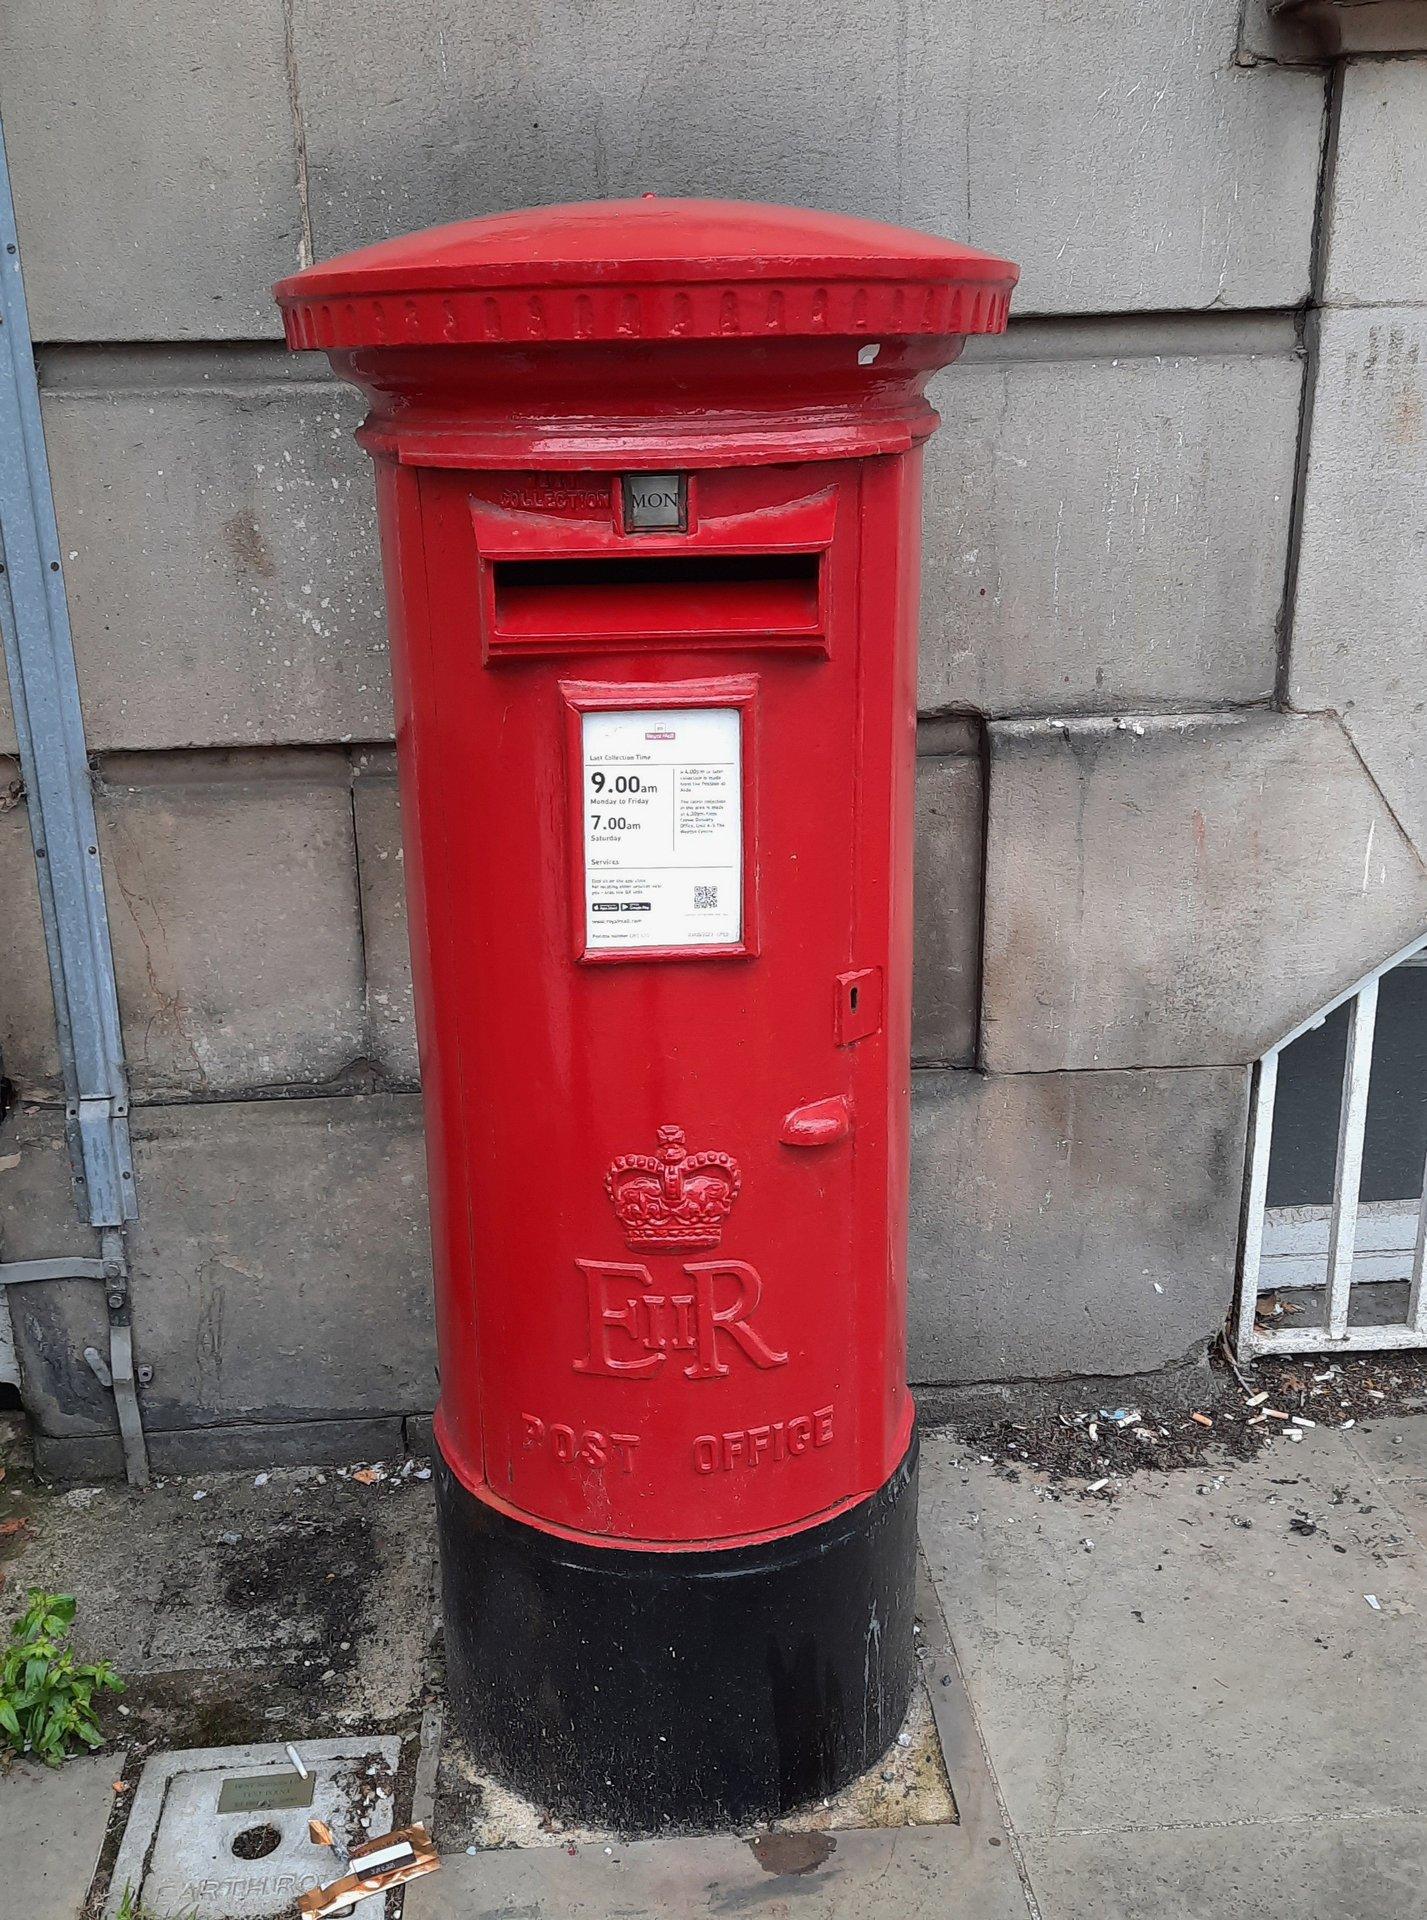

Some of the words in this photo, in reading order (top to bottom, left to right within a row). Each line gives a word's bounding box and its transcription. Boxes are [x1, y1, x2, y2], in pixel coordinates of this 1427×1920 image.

[632, 492, 679, 509] MON
[591, 771, 658, 794] 9.00am
[590, 815, 641, 830] 7.00am
[590, 834, 621, 842] Saturday
[591, 858, 619, 866] Services
[521, 1411, 641, 1474] POST
[692, 1403, 835, 1475] OFFICE
